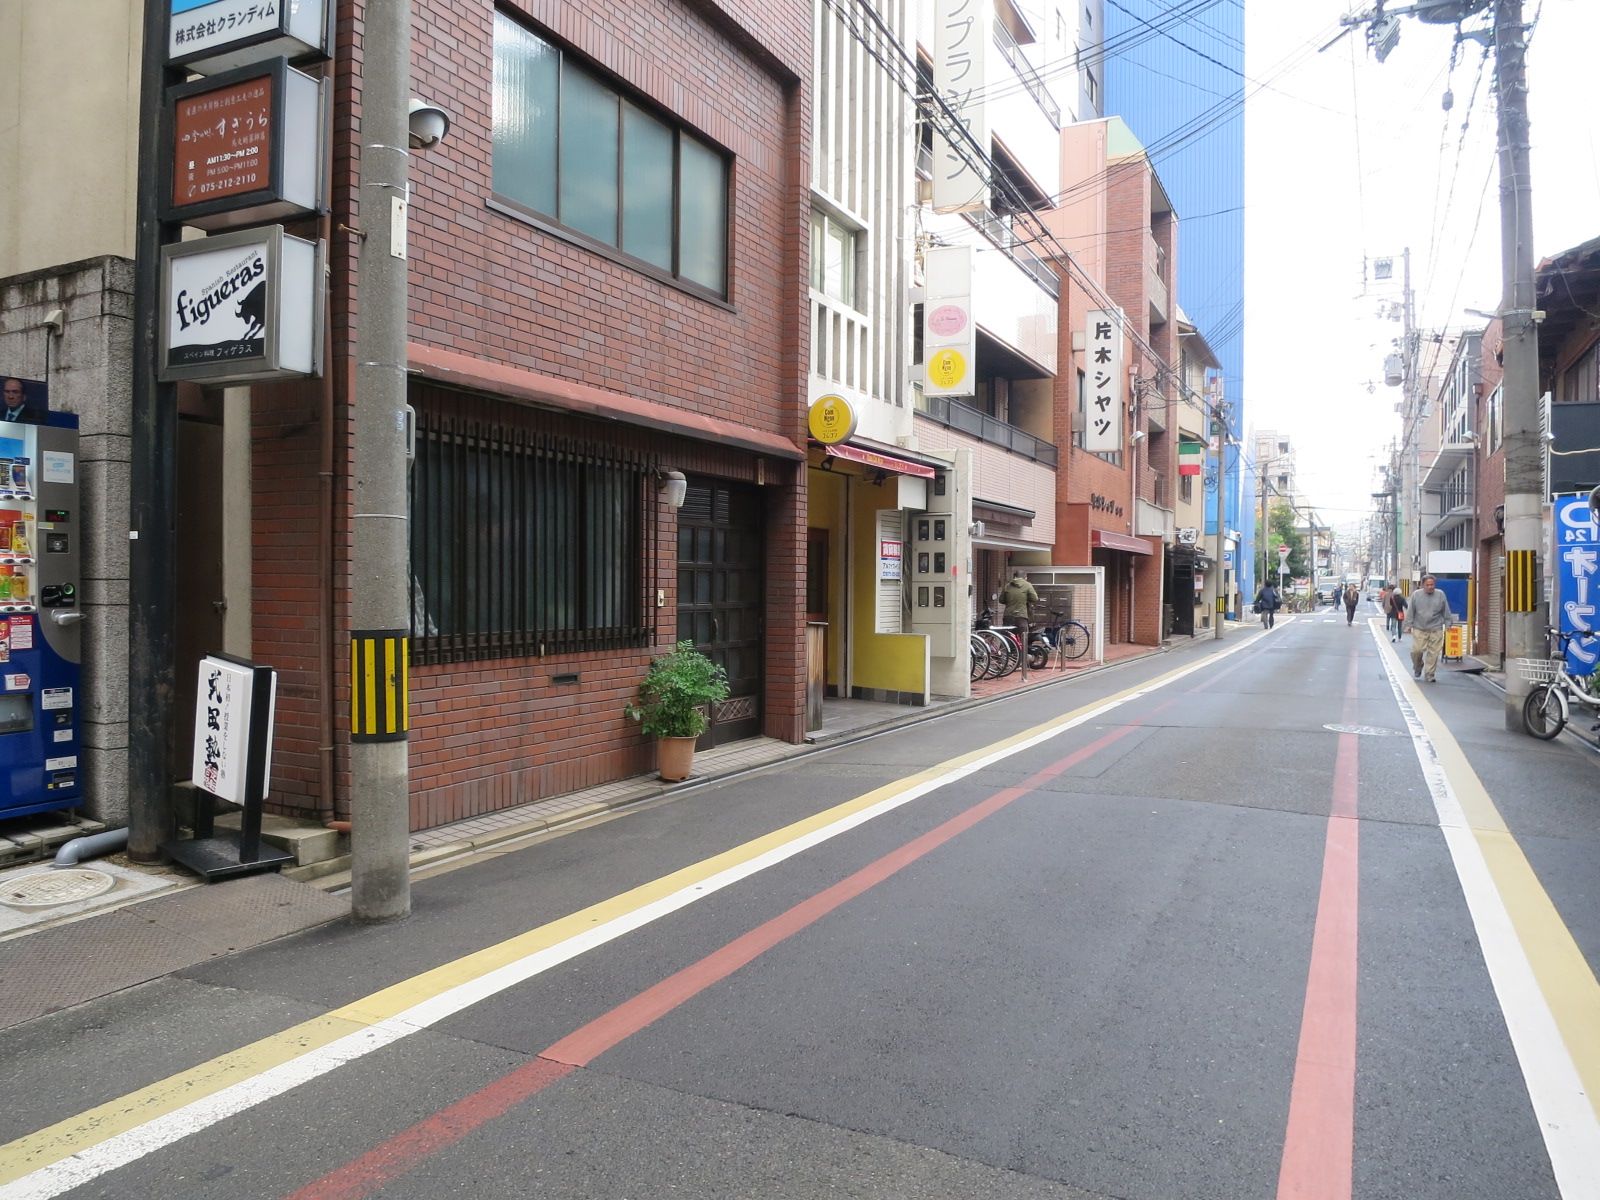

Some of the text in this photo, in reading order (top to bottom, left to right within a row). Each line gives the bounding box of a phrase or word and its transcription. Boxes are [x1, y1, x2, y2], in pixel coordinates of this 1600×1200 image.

[175, 1, 275, 46] 株式会社クランディム
[246, 146, 259, 156] 2:00
[200, 173, 257, 193] 075-212-2110
[201, 250, 258, 296] Spanish Restaurant
[176, 257, 265, 331] figueras
[216, 344, 253, 357] フィゲラス
